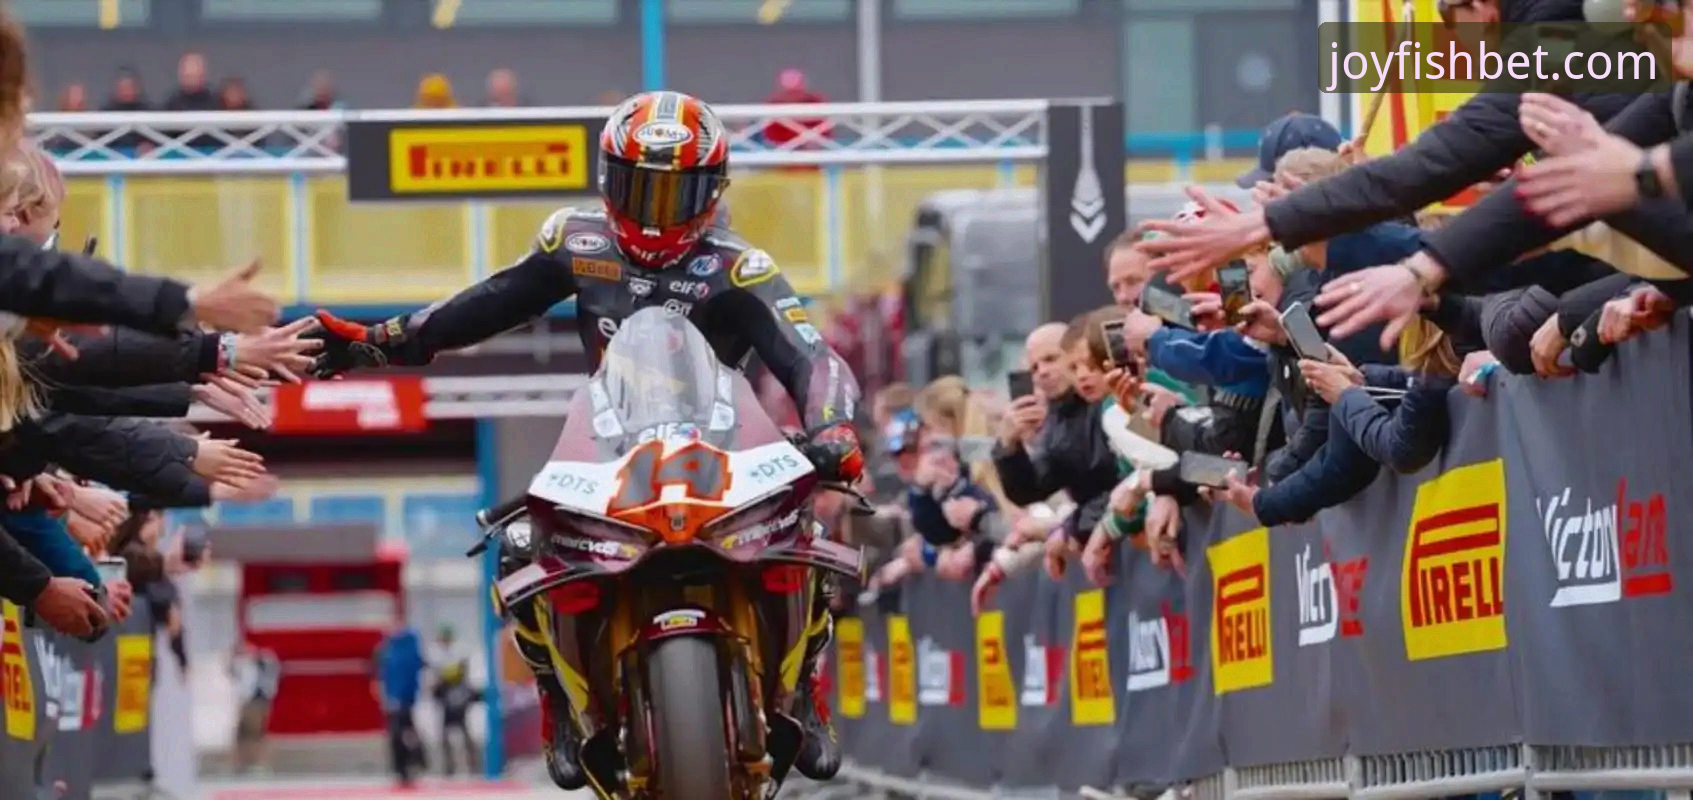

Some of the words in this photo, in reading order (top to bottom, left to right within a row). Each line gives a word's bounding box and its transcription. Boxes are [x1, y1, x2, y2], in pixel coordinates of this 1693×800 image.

[759, 454, 799, 478] DTS
[558, 474, 599, 495] DTS
[1408, 502, 1503, 628] PIRELL
